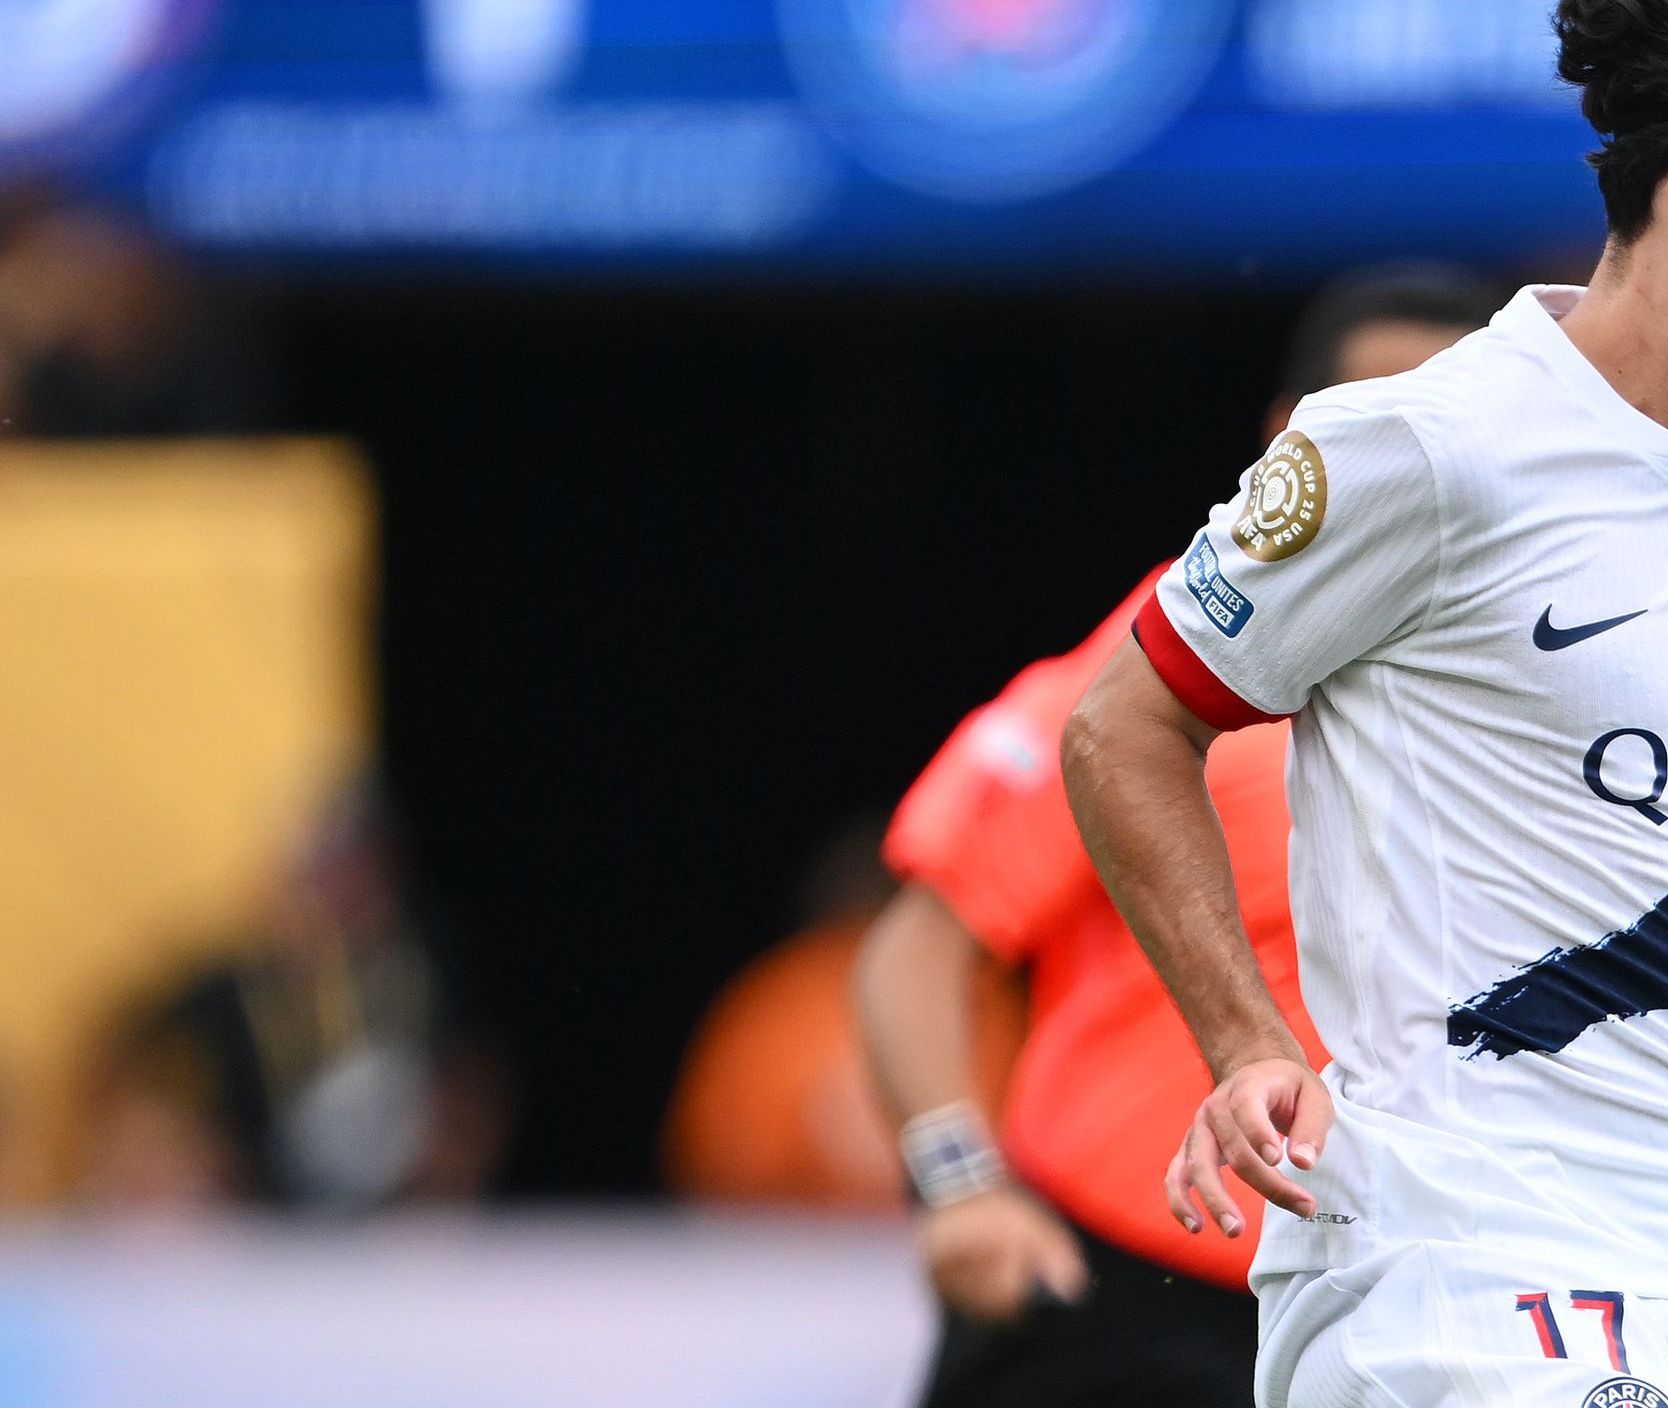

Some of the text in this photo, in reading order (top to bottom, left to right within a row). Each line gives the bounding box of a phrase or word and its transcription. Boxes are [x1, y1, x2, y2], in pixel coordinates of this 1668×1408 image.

[1266, 442, 1303, 463] WORLD
[1300, 460, 1317, 494] CUP
[1300, 499, 1314, 521] 25
[1273, 522, 1304, 546] USA
[1210, 575, 1245, 612] UNITES
[1207, 600, 1230, 624] FIFA
[1514, 1288, 1631, 1376] 17
